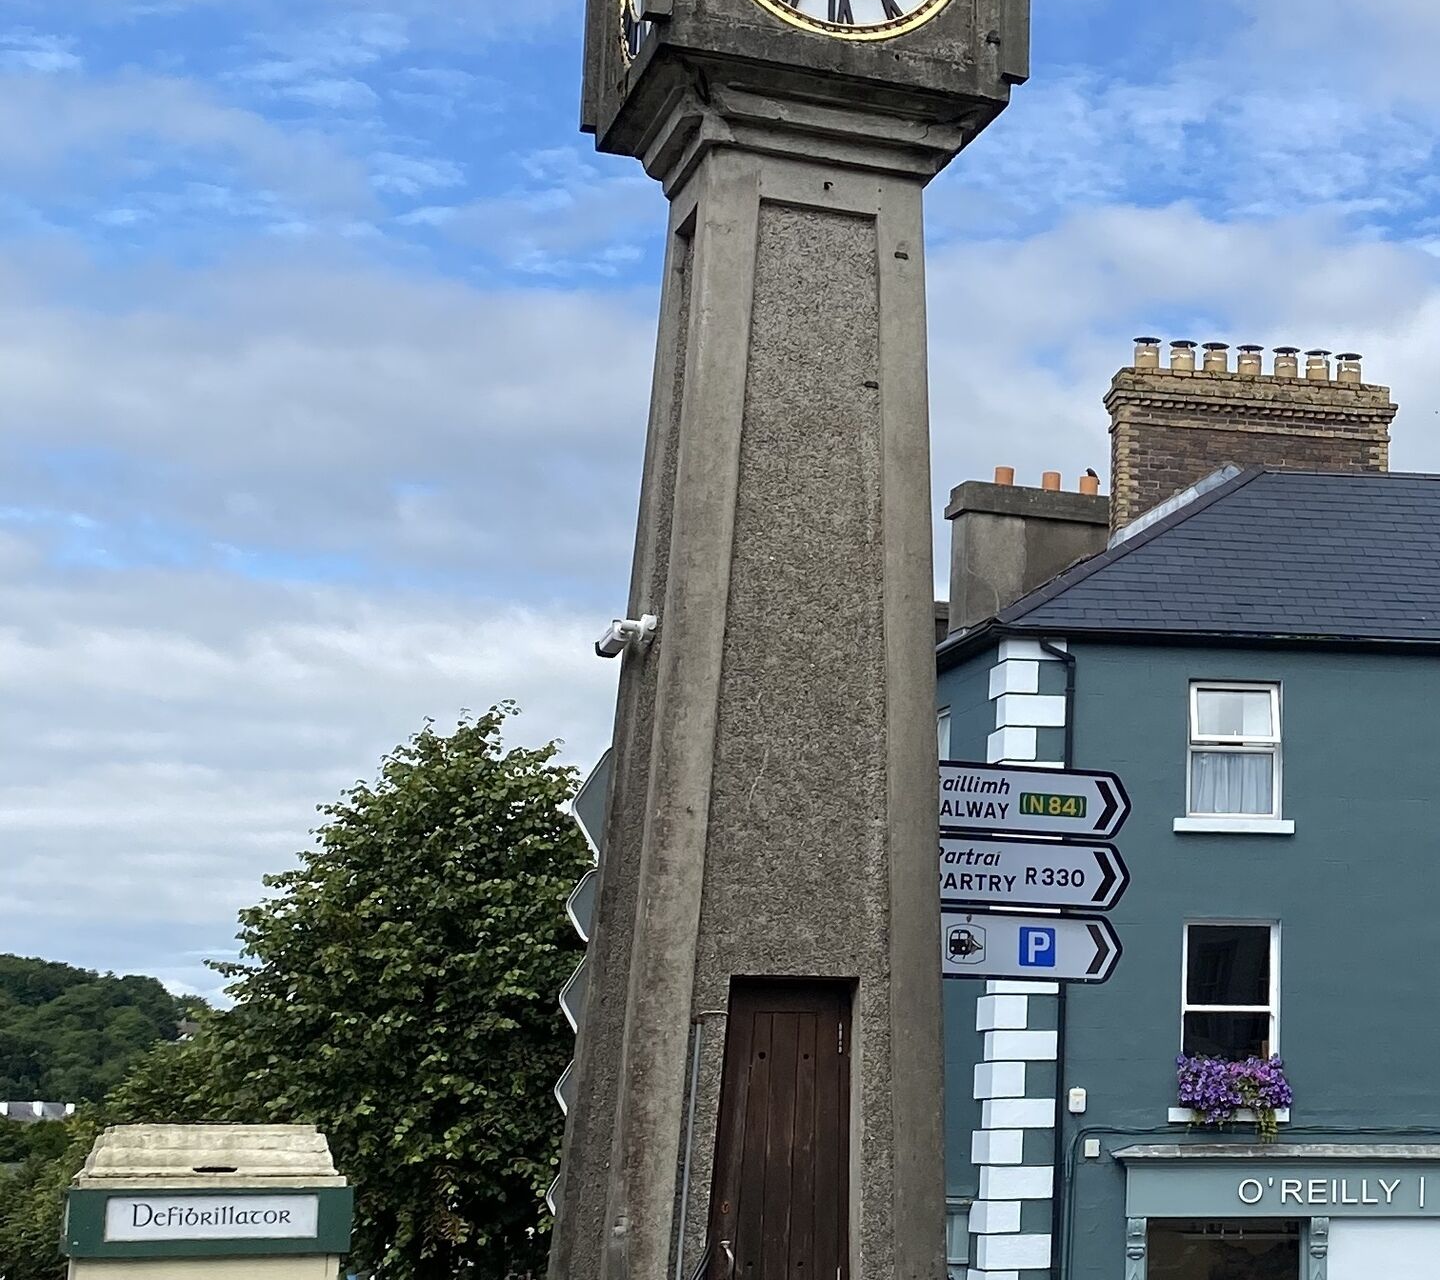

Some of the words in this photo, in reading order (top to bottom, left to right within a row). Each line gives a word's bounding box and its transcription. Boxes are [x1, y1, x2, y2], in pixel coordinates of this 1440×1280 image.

[940, 775, 1011, 795] aillimh
[940, 799, 1010, 820] ALWAY
[1028, 931, 1051, 963] P
[1238, 1178, 1401, 1205] O'REILLY
[132, 1203, 291, 1228] Defibrillator
